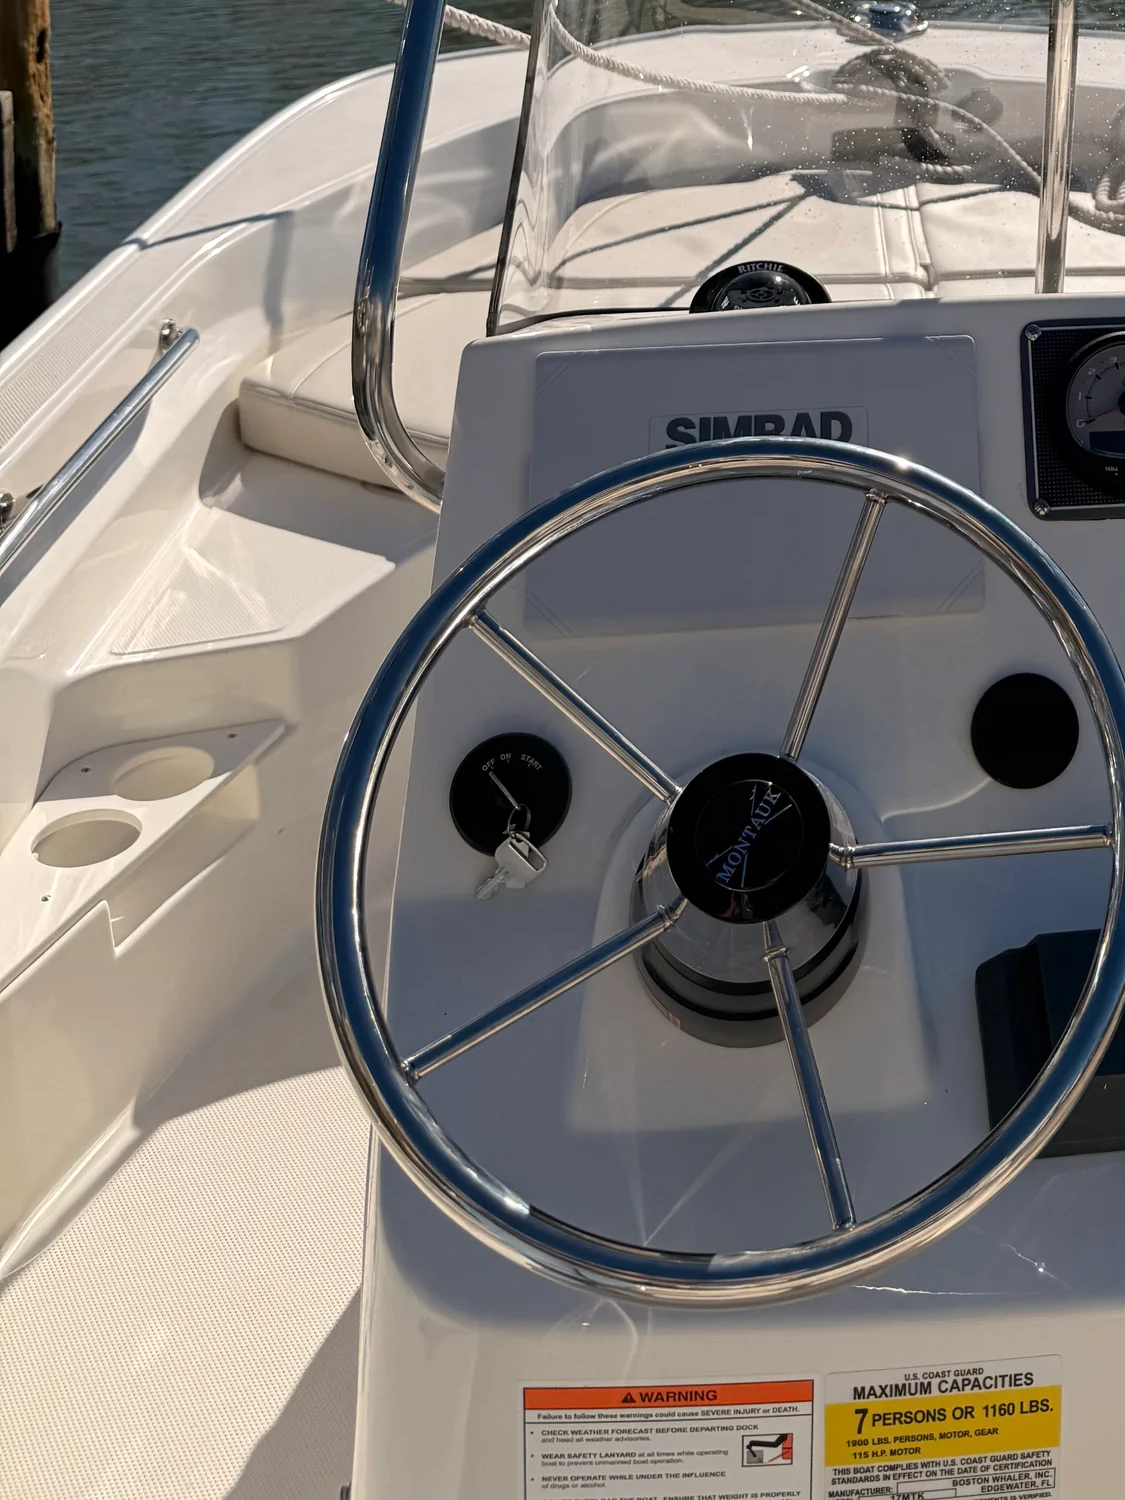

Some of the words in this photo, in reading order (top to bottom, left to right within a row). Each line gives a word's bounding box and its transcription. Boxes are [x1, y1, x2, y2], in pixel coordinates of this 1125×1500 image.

[738, 262, 784, 274] RITCHIE
[1109, 356, 1118, 364] 3
[1078, 392, 1082, 400] 1
[500, 753, 512, 761] ON
[520, 754, 542, 771] START
[482, 758, 496, 772] OFF
[716, 788, 782, 883] MONTAUK
[904, 1373, 920, 1381] U.S.
[922, 1370, 952, 1380] COAST
[953, 1368, 984, 1377] GUARD
[853, 1382, 932, 1400] MAXIMUM
[938, 1373, 1034, 1393] CAPACITIES
[639, 1390, 718, 1403] WARNING
[854, 1408, 868, 1434] 7
[872, 1408, 946, 1426] PERSONS
[952, 1406, 974, 1420] OR
[982, 1403, 1015, 1418] 1160
[1020, 1399, 1054, 1414] LBS.
[846, 1439, 869, 1447] 1900
[872, 1437, 891, 1445] LBS.
[893, 1433, 937, 1443] PERSONS,
[939, 1430, 972, 1439] MOTOR,
[974, 1428, 999, 1436] GEAR
[852, 1451, 869, 1459] 115
[871, 1449, 887, 1458] H.P.
[889, 1447, 921, 1456] MOTOR
[832, 1468, 851, 1476] THIS
[853, 1466, 875, 1475] BOAT
[877, 1463, 919, 1472] COMPLIES
[920, 1461, 941, 1469] WITH
[943, 1459, 958, 1467] U.S.
[960, 1456, 988, 1465] COAST
[989, 1453, 1019, 1463] GUARD
[1020, 1450, 1051, 1460] SAFETY
[831, 1475, 881, 1485] STANDARDS
[892, 1471, 924, 1480] EFFECT
[925, 1470, 937, 1478] ON
[939, 1468, 955, 1476] THE
[957, 1466, 978, 1475] DATE
[979, 1465, 991, 1473] OF
[993, 1459, 1052, 1471] CERTIFICATION
[952, 1477, 990, 1487] BOSTON
[992, 1473, 1032, 1483] WHALER,
[1034, 1471, 1052, 1479] INC.
[828, 1487, 893, 1498] MANUFACTURER:
[981, 1481, 1039, 1493] EDGEWATER,
